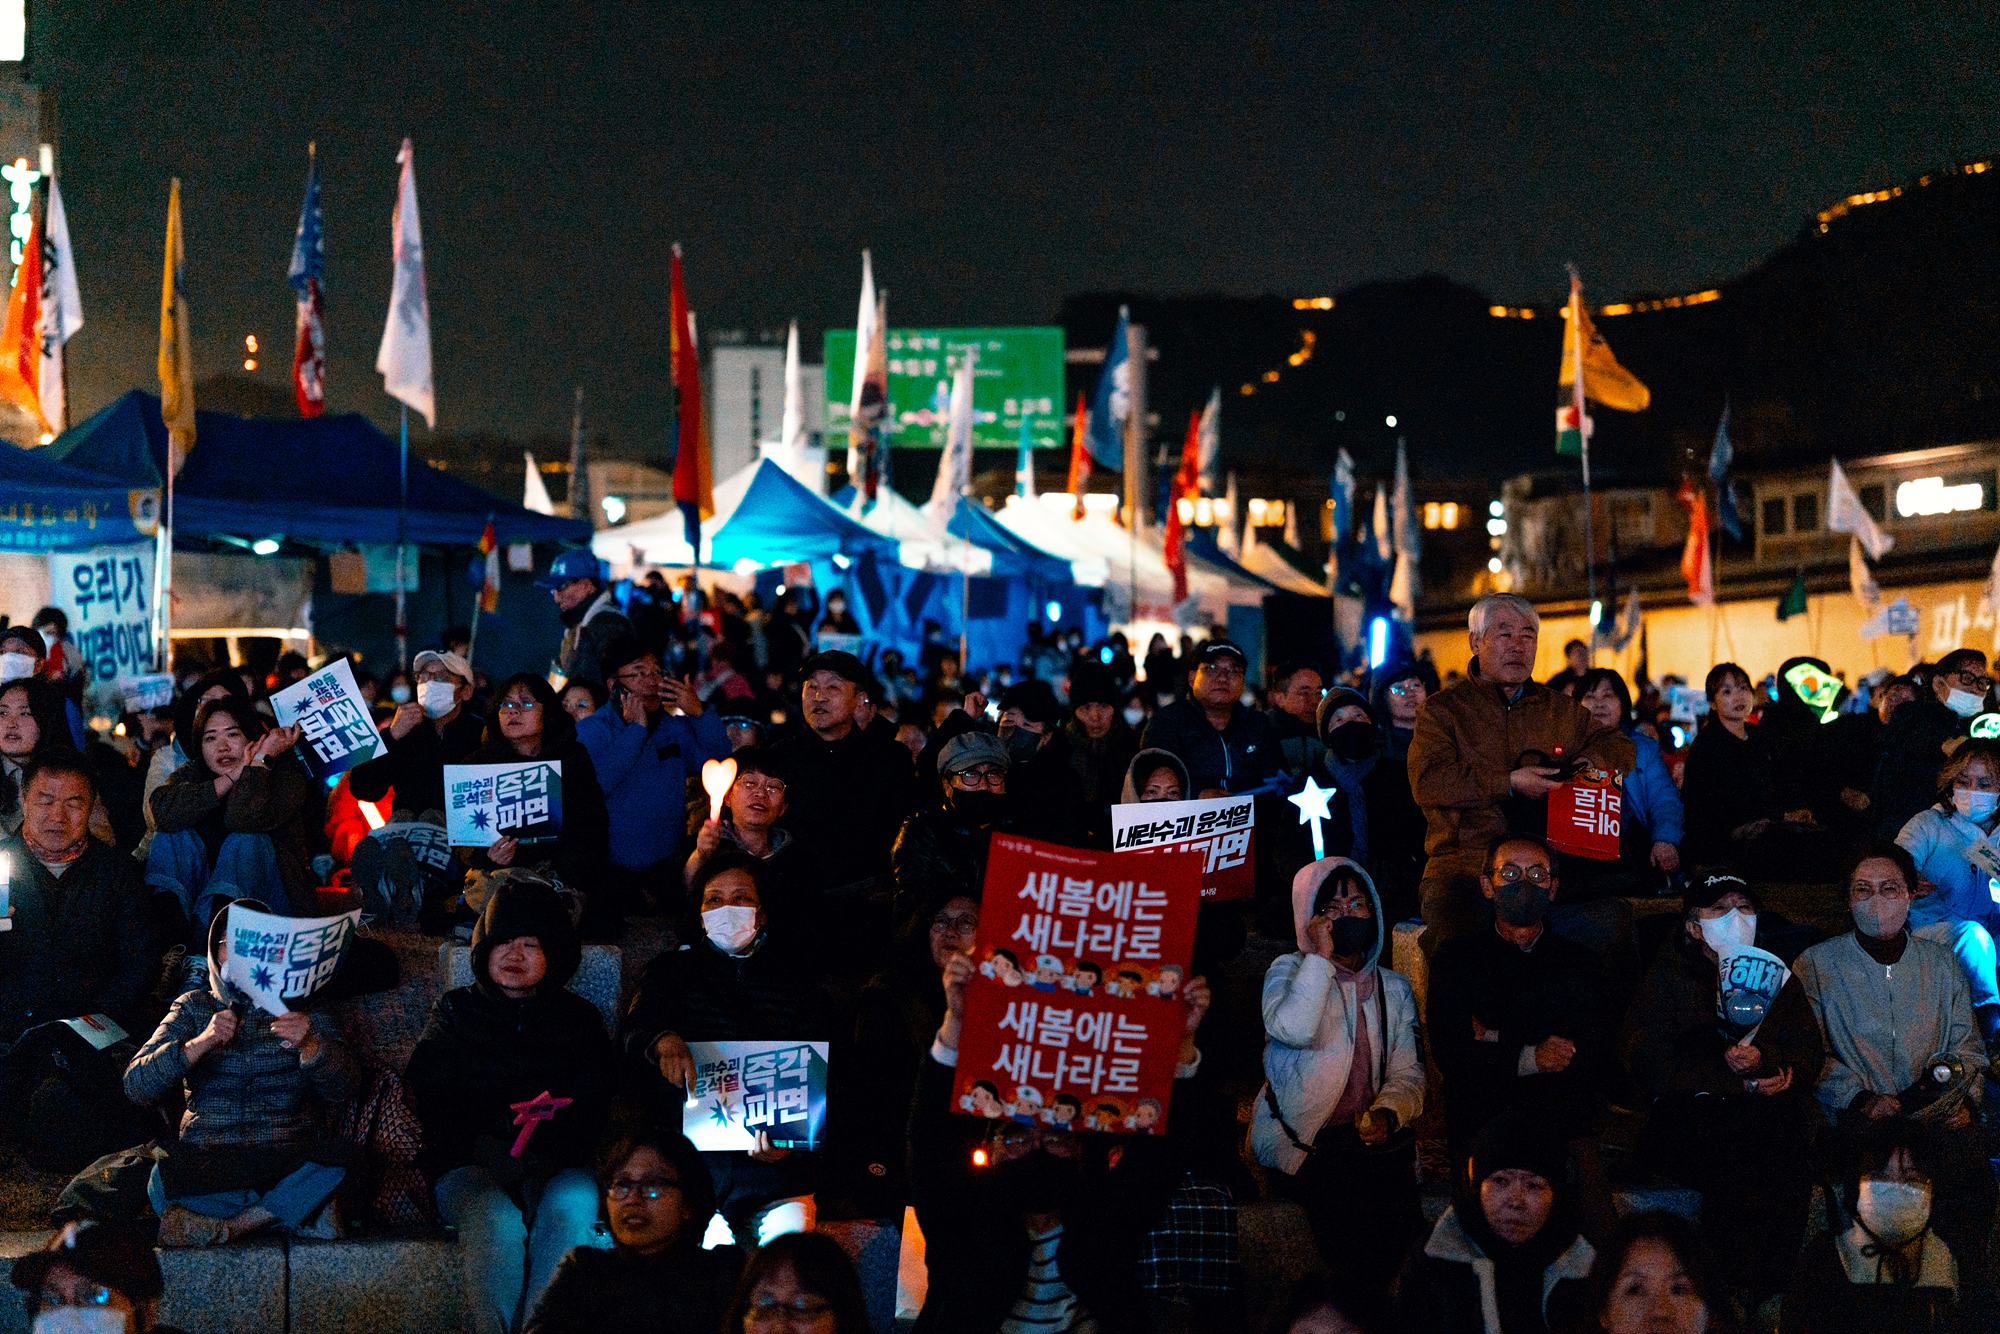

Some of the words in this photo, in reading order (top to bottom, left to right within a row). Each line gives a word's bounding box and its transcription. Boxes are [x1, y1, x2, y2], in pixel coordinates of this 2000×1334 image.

[72, 557, 146, 620] 우리가
[299, 711, 350, 763] 파면
[327, 700, 377, 751] 즉각
[451, 777, 494, 794] 내란수괴
[452, 789, 494, 809] 윤석열
[498, 765, 549, 800] 즉각
[498, 795, 549, 829] 파면
[1116, 815, 1196, 849] 내란수괴
[1196, 802, 1252, 836] 윤석열
[1018, 871, 1168, 921] 새봄에는
[293, 918, 349, 963] 즉각
[1011, 913, 1162, 961] 새나라로
[282, 953, 340, 998] 파면
[998, 1002, 1148, 1054] 새봄에는
[745, 1047, 811, 1089] 즉각
[991, 1044, 1140, 1094] 새나라로
[745, 1085, 808, 1127] 파면
